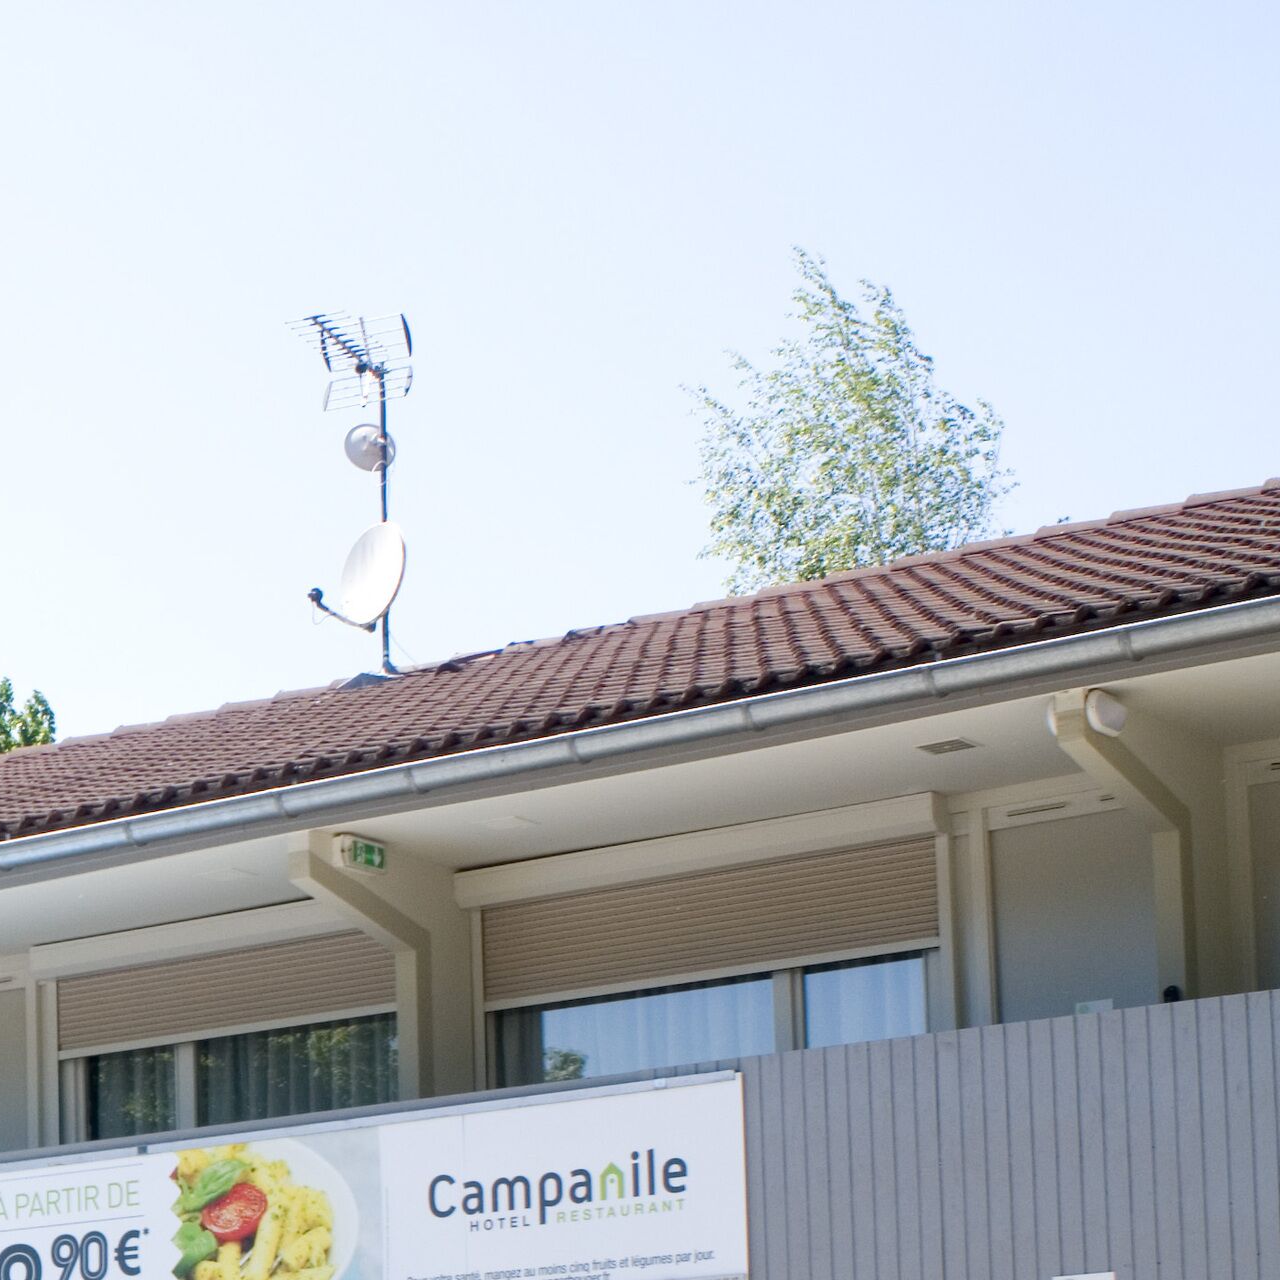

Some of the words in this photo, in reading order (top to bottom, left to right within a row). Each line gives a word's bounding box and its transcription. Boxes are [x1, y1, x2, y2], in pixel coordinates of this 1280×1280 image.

[15, 1185, 100, 1219] PARTIR
[107, 1180, 140, 1209] DE
[427, 1148, 688, 1225] Campanile
[468, 1215, 532, 1232] HOTEL
[555, 1199, 686, 1224] RESTAURANT
[484, 1267, 521, 1280] mangez
[523, 1267, 536, 1277] au
[538, 1263, 567, 1275] moins
[569, 1261, 590, 1273] cinq
[592, 1259, 616, 1270] fruits
[619, 1257, 629, 1268] et
[631, 1254, 672, 1269] légumes
[675, 1252, 692, 1265] par
[693, 1249, 715, 1264] jour.
